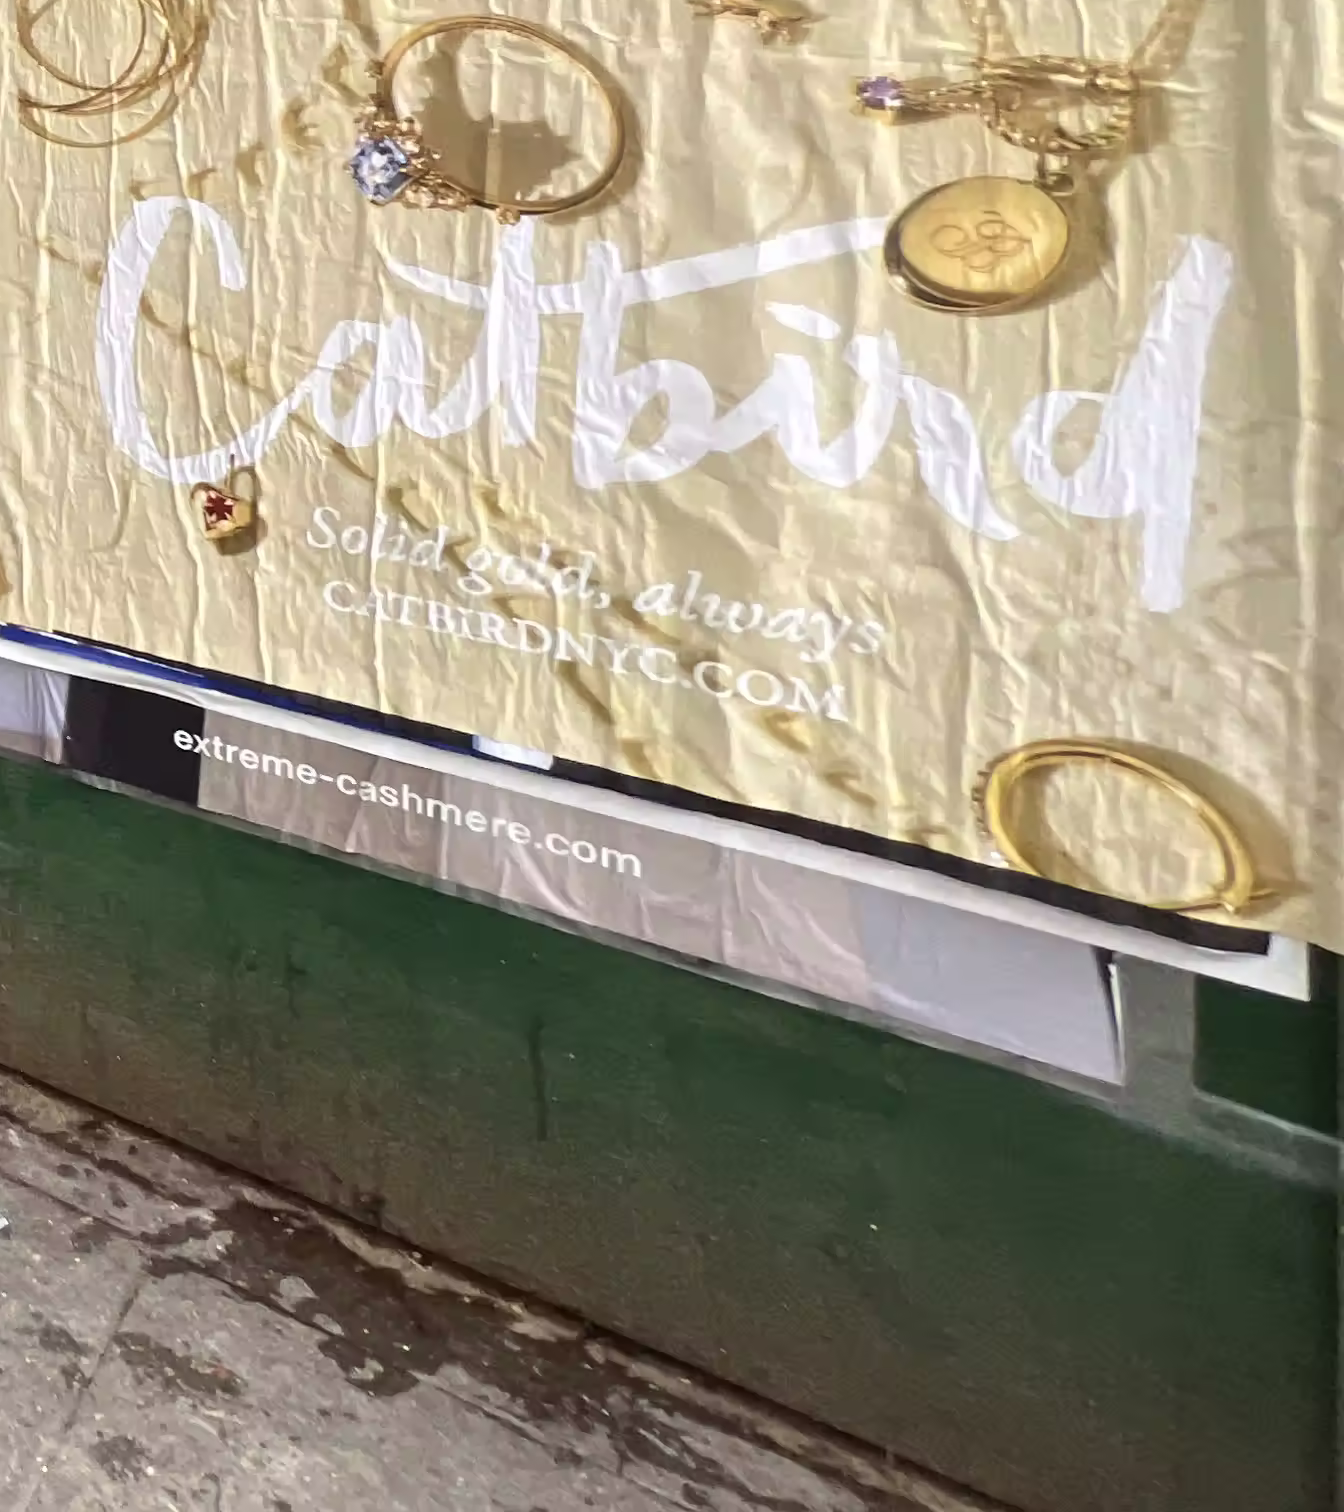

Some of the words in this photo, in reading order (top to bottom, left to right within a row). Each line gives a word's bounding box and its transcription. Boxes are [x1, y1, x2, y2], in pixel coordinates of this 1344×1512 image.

[95, 195, 1234, 613] Catbird
[306, 505, 450, 572] Solid
[457, 542, 612, 611] gold,
[633, 570, 885, 664] always
[322, 579, 850, 723] CATBIRDNYC.COM
[173, 728, 643, 878] extreme-cashmere.com
